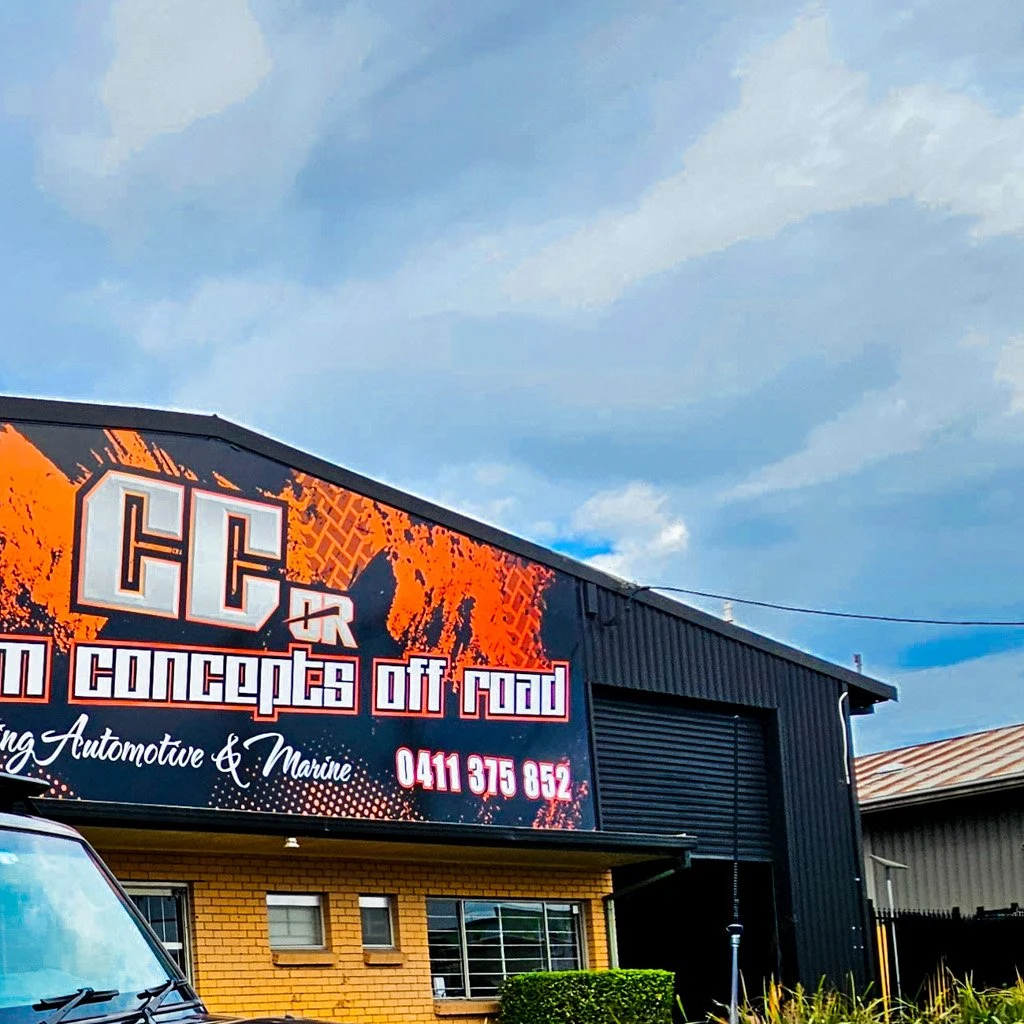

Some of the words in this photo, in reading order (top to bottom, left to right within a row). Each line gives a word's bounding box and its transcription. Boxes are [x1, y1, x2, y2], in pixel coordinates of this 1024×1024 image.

[77, 470, 282, 631] CC
[285, 587, 358, 648] OR
[74, 646, 355, 715] concepts
[375, 656, 448, 712] off
[462, 666, 566, 717] road
[39, 713, 205, 768] Automotive
[211, 732, 251, 789] &
[243, 732, 353, 783] Marine
[396, 747, 462, 793] 0411
[468, 754, 517, 799] 375
[523, 761, 573, 802] 852
